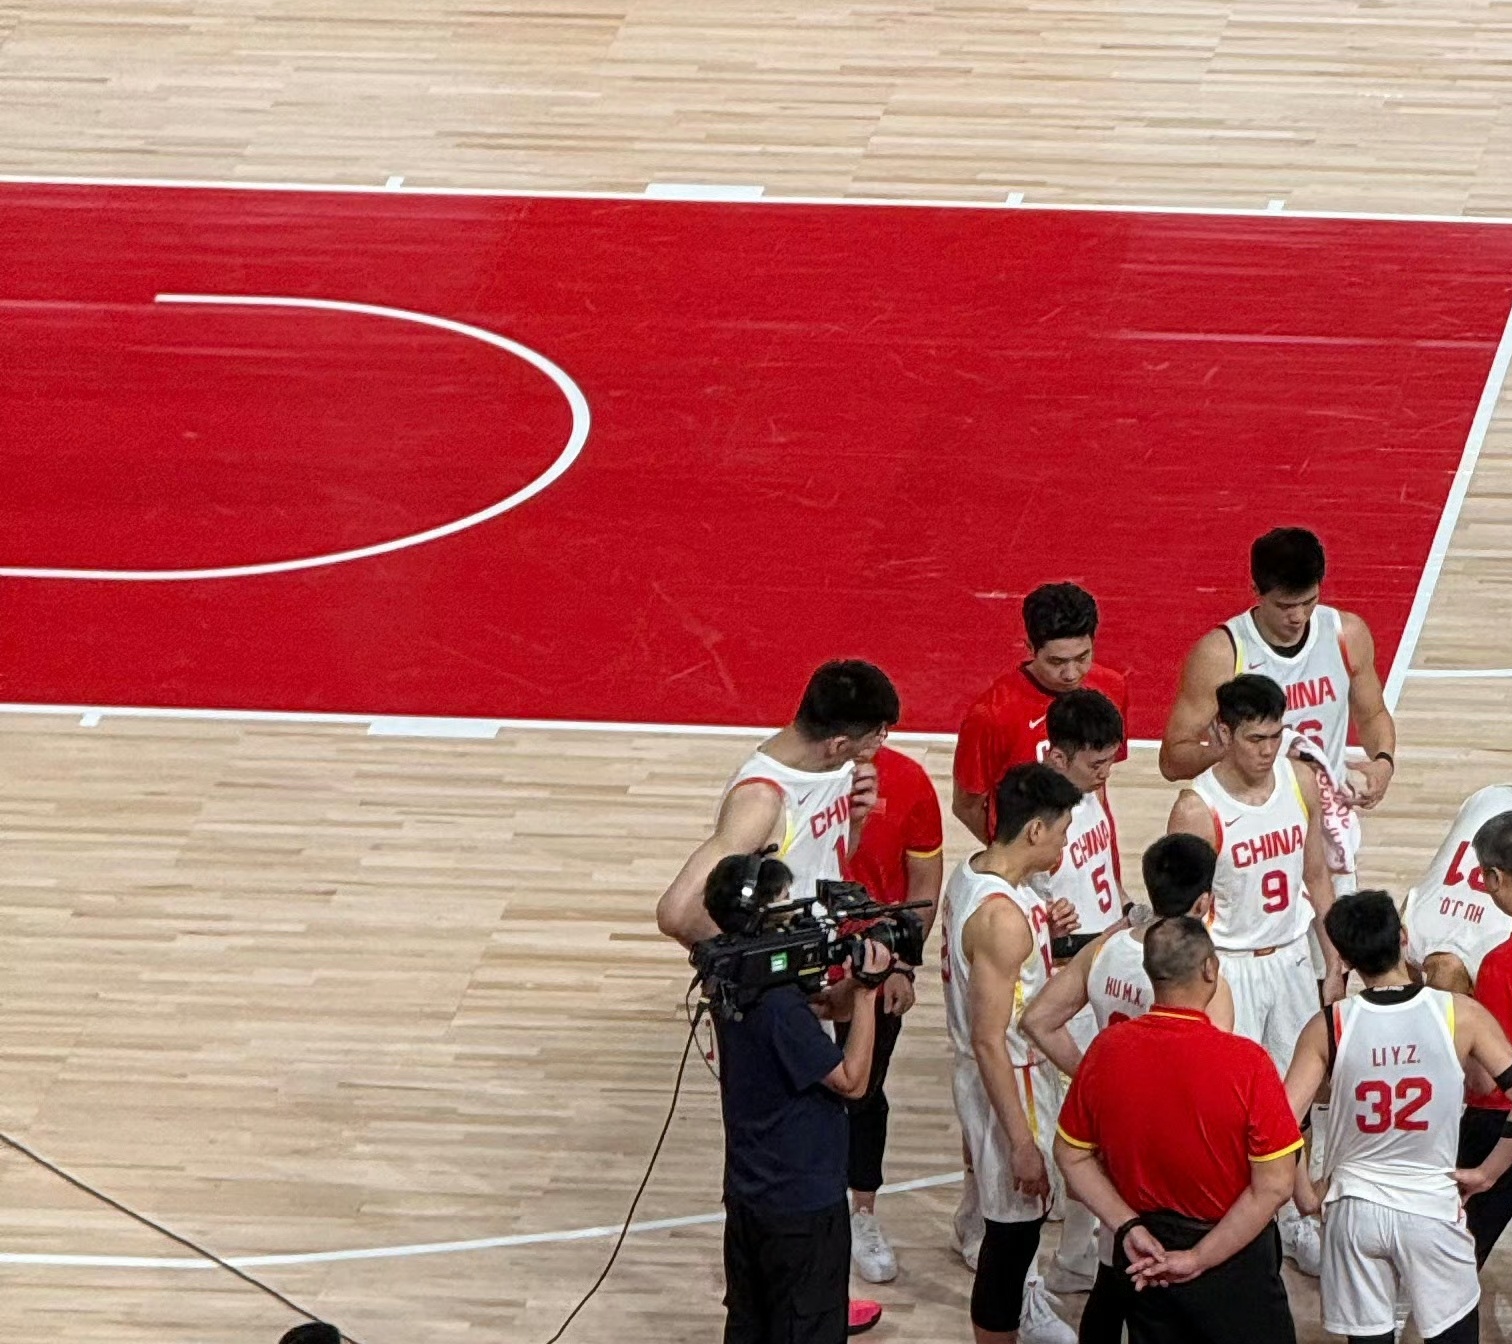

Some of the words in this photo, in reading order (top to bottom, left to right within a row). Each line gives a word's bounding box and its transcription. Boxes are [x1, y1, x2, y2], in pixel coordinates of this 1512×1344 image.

[1231, 824, 1304, 869] CHINA
[1091, 864, 1112, 914] 5
[1262, 869, 1289, 914] 9
[1104, 976, 1122, 998] HU
[1372, 1047, 1386, 1067] LI
[1391, 1044, 1421, 1066] Y.Z.
[1355, 1076, 1433, 1135] 32
